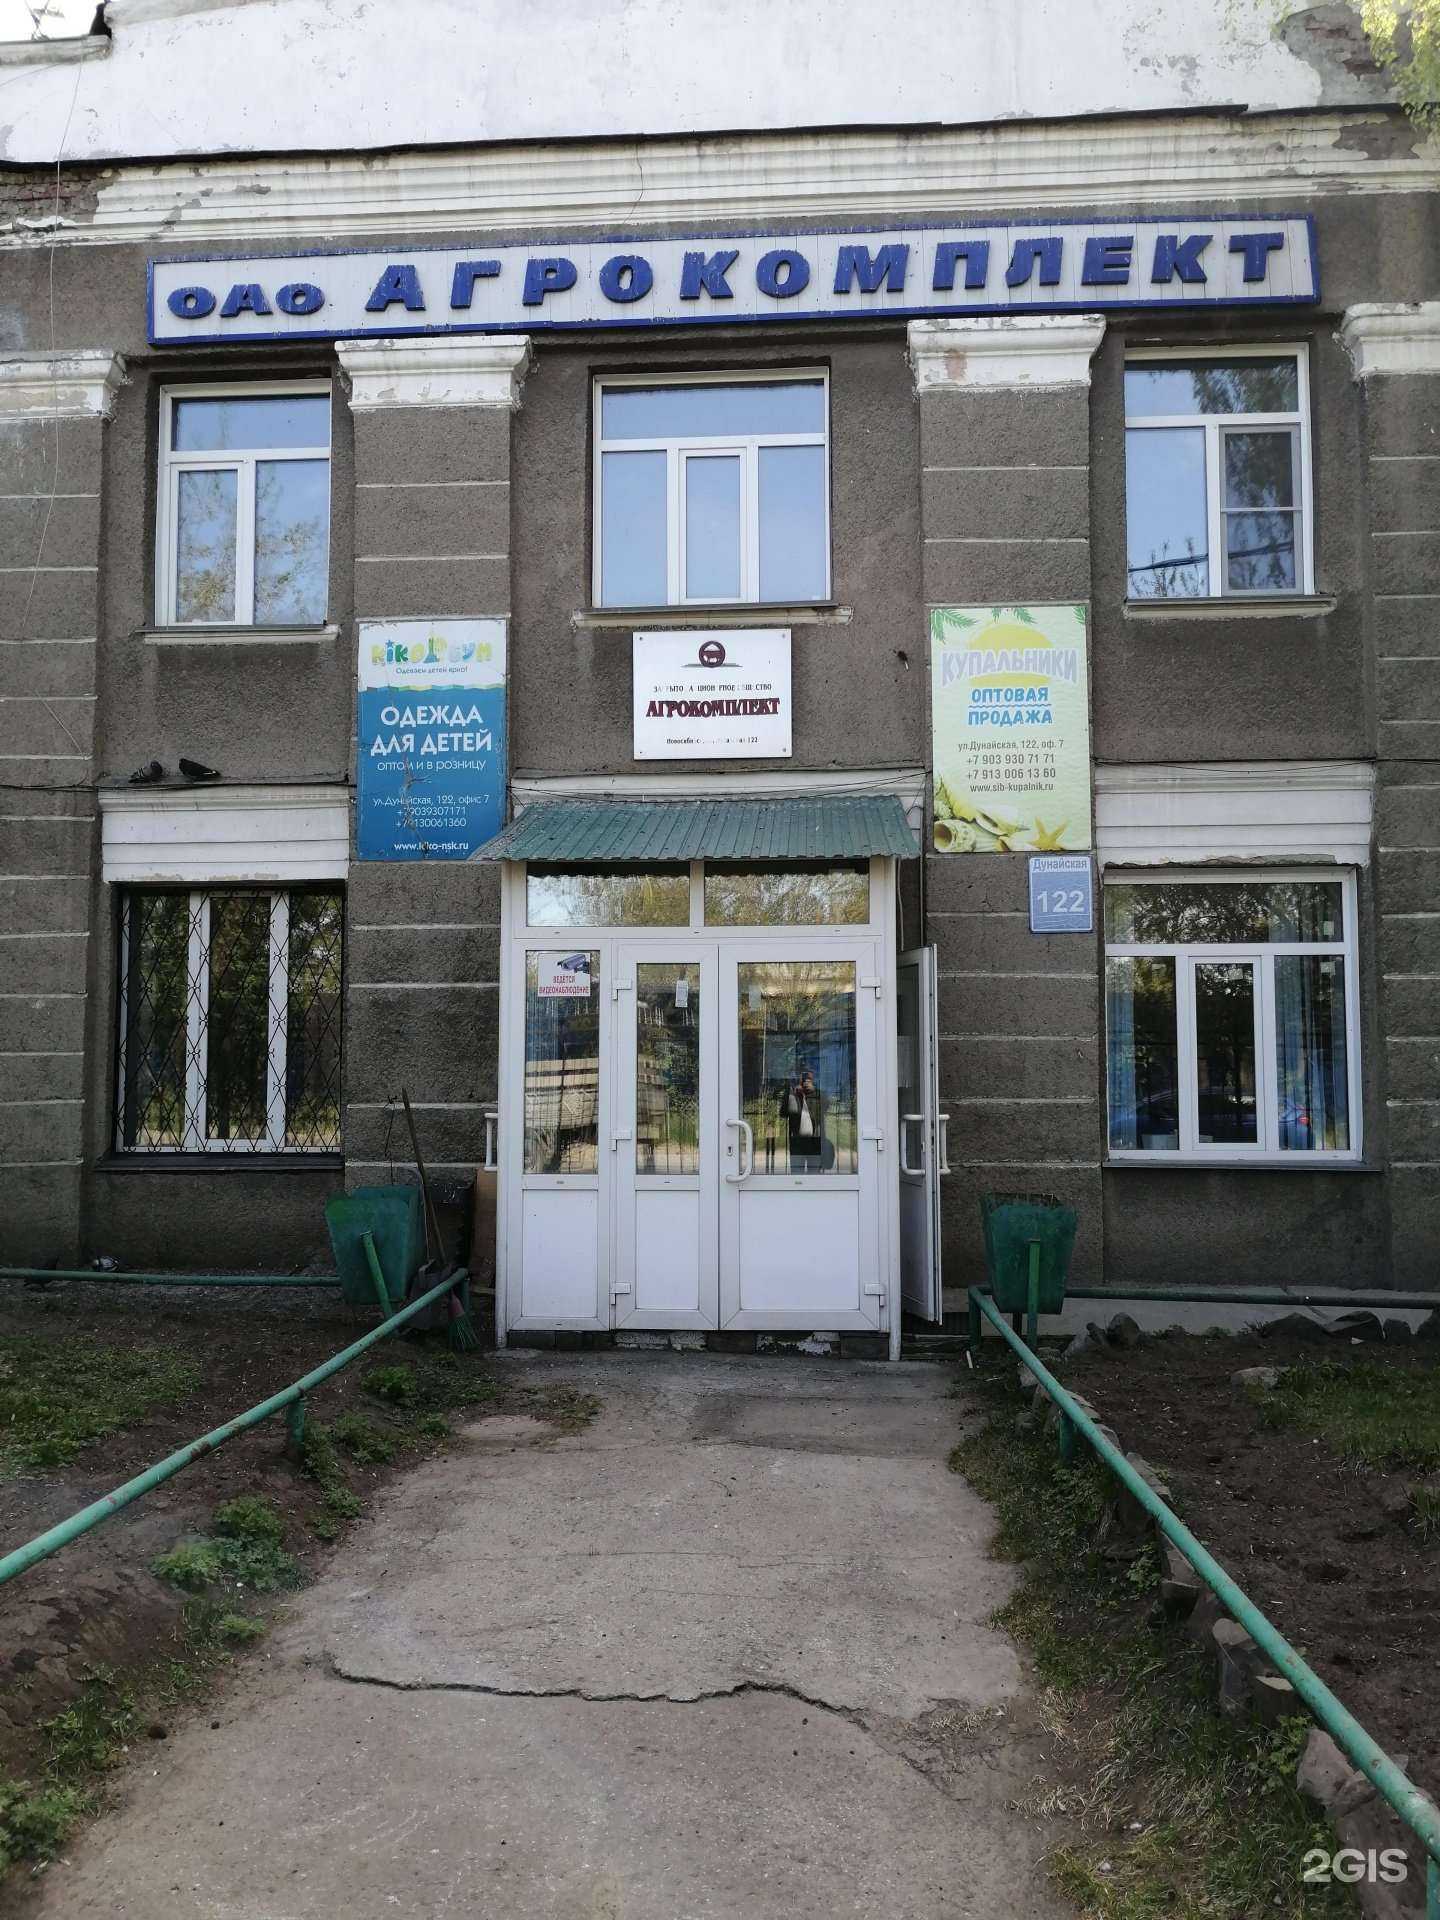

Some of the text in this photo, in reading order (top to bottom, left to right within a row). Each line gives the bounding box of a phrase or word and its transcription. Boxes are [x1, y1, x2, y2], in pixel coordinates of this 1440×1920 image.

[168, 232, 1285, 319] ОАО АГРОКОМПЛЕКТ
[942, 649, 1078, 687] КУПАЛЬНИКИ
[971, 687, 1049, 702] ОПТОВАЯ
[646, 697, 780, 718] АГРОКОМПЛЕКТ
[381, 704, 484, 729] ОДЕЖДА
[967, 709, 1053, 727] ПРОДАЖА
[370, 729, 492, 757] ДЛЯ ДЕТЕЙ
[1041, 739, 1056, 750] оф.
[1058, 739, 1065, 748] 7
[416, 760, 424, 770] и
[426, 760, 433, 770] в
[436, 759, 487, 772] розницу
[966, 753, 1055, 765] +7 903 930 71 71
[966, 767, 1056, 779] +7 913 006 13 60
[970, 782, 1054, 793] www.sib-kupalnik.ru
[458, 794, 482, 807] офис
[483, 794, 490, 804] 7
[1032, 857, 1087, 870] Дунайская
[1037, 890, 1085, 912] 122
